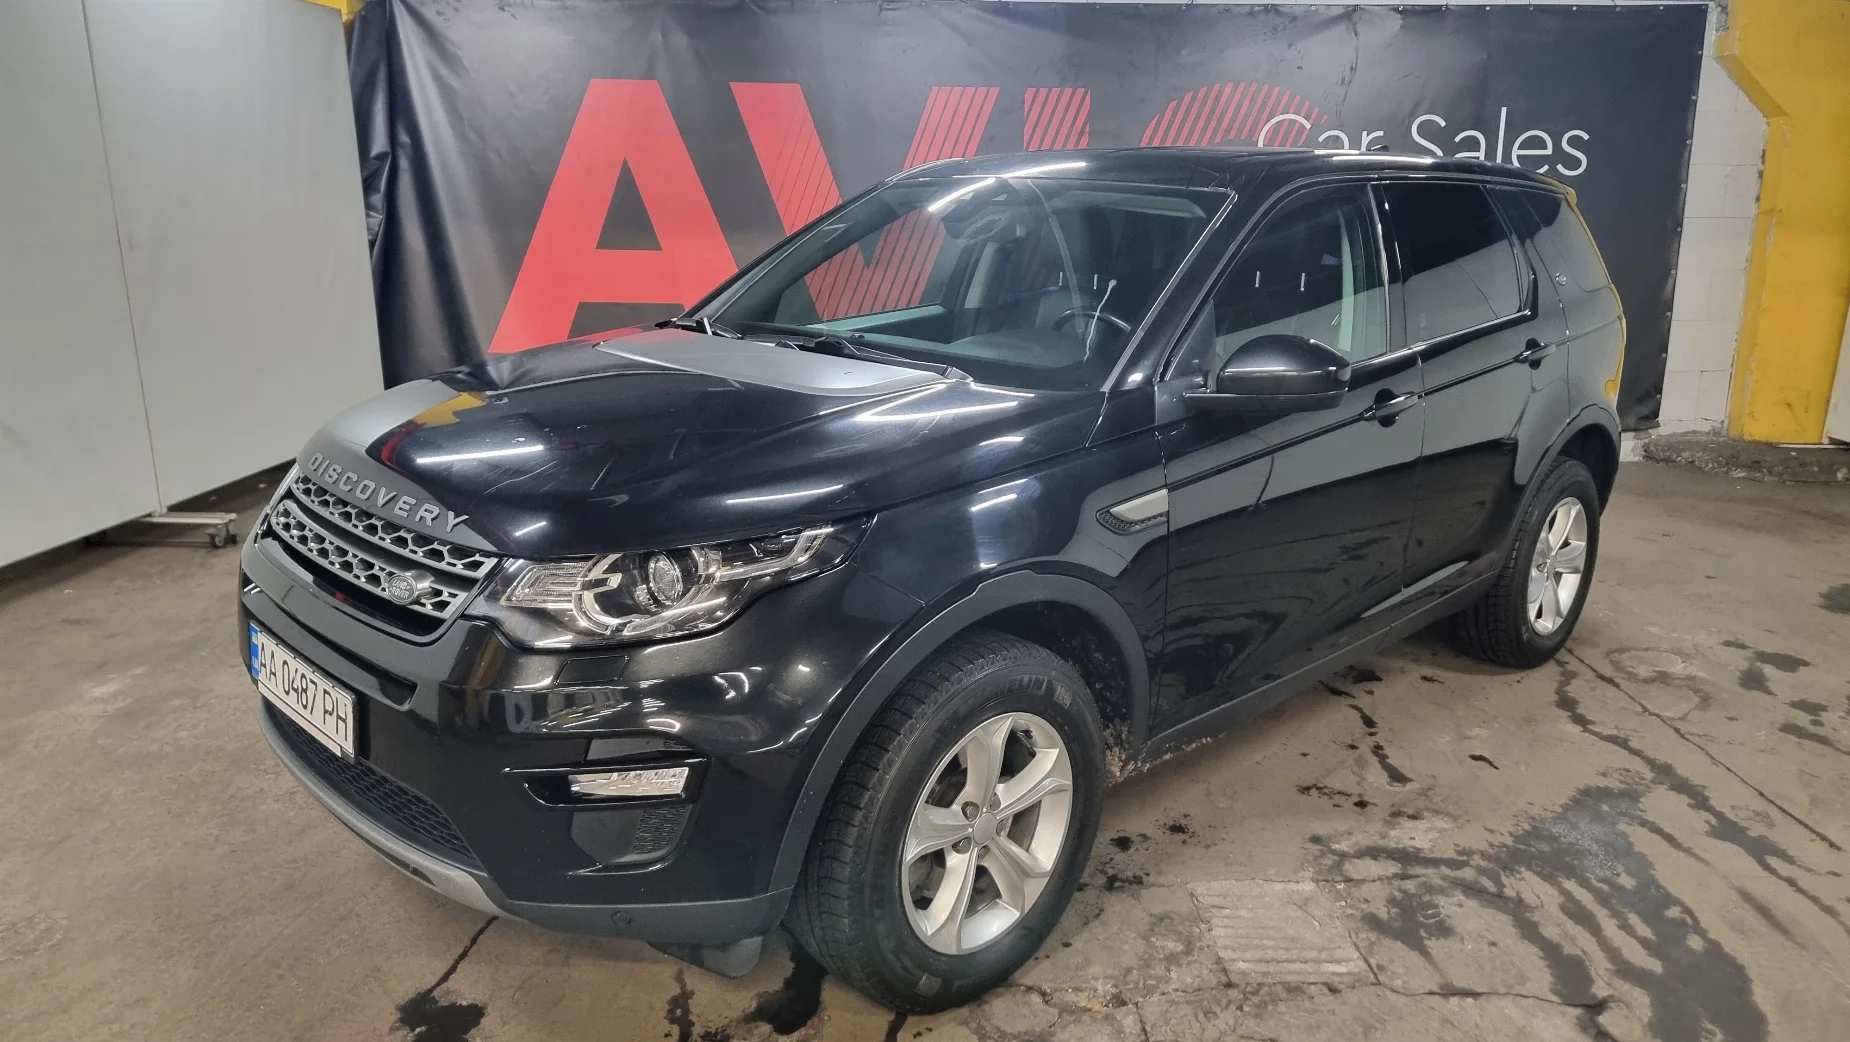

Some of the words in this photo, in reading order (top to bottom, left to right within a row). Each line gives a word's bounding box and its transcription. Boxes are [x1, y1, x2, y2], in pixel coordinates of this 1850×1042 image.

[1410, 106, 1591, 177] Sales
[488, 78, 1328, 354] AV
[307, 451, 470, 533] DISCOVERY
[259, 640, 279, 689] AA
[281, 658, 318, 716] 0487
[322, 686, 348, 742] PH
